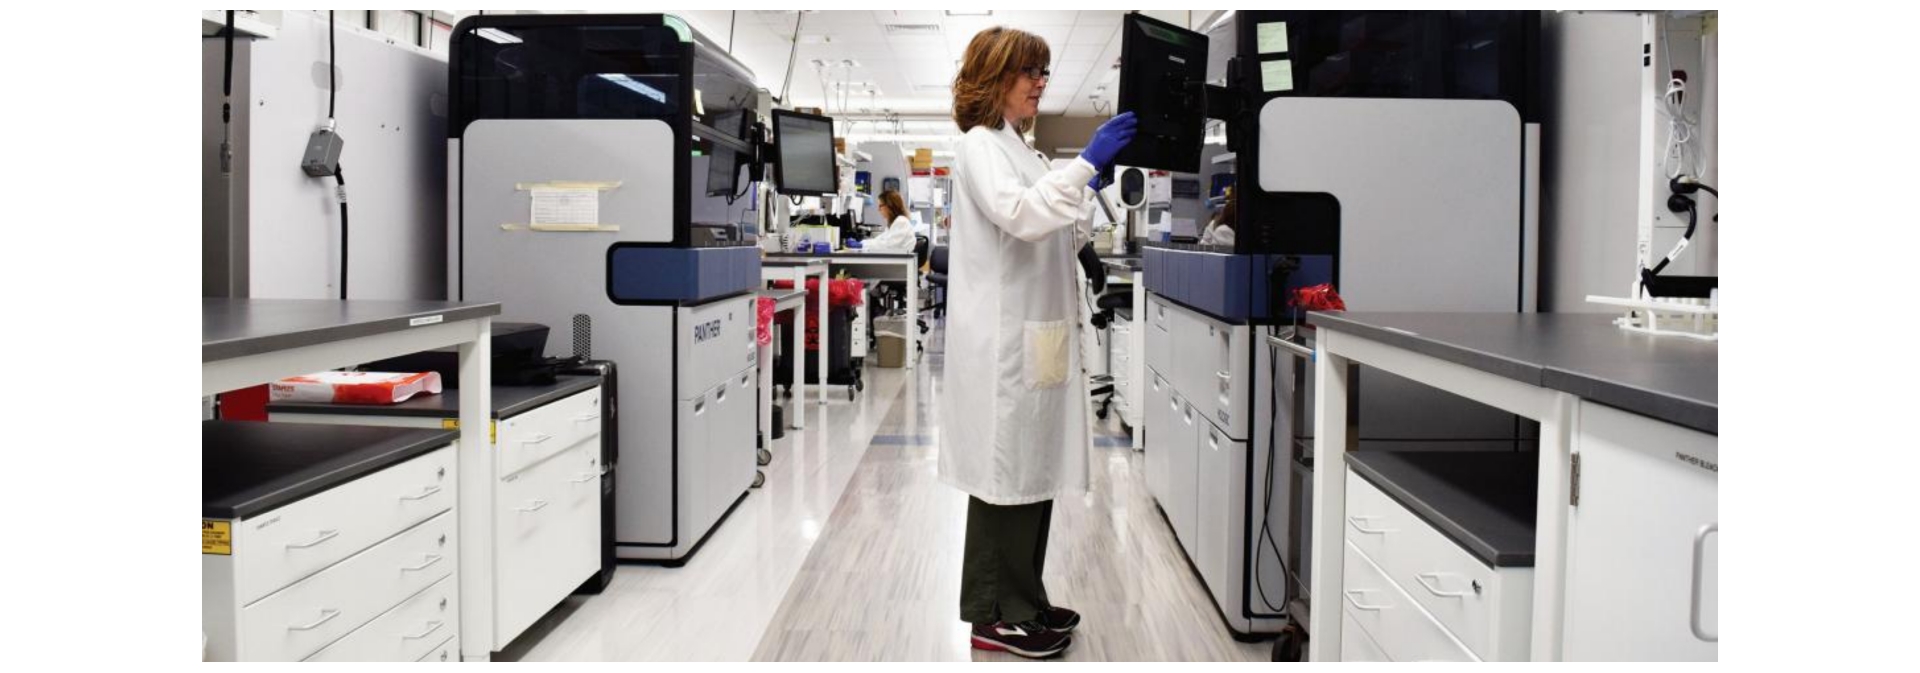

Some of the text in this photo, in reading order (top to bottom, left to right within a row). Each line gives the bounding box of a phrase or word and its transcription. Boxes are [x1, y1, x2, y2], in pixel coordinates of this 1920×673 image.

[695, 319, 721, 345] PANTHER
[1675, 451, 1718, 472] PANTHER BLEAC
